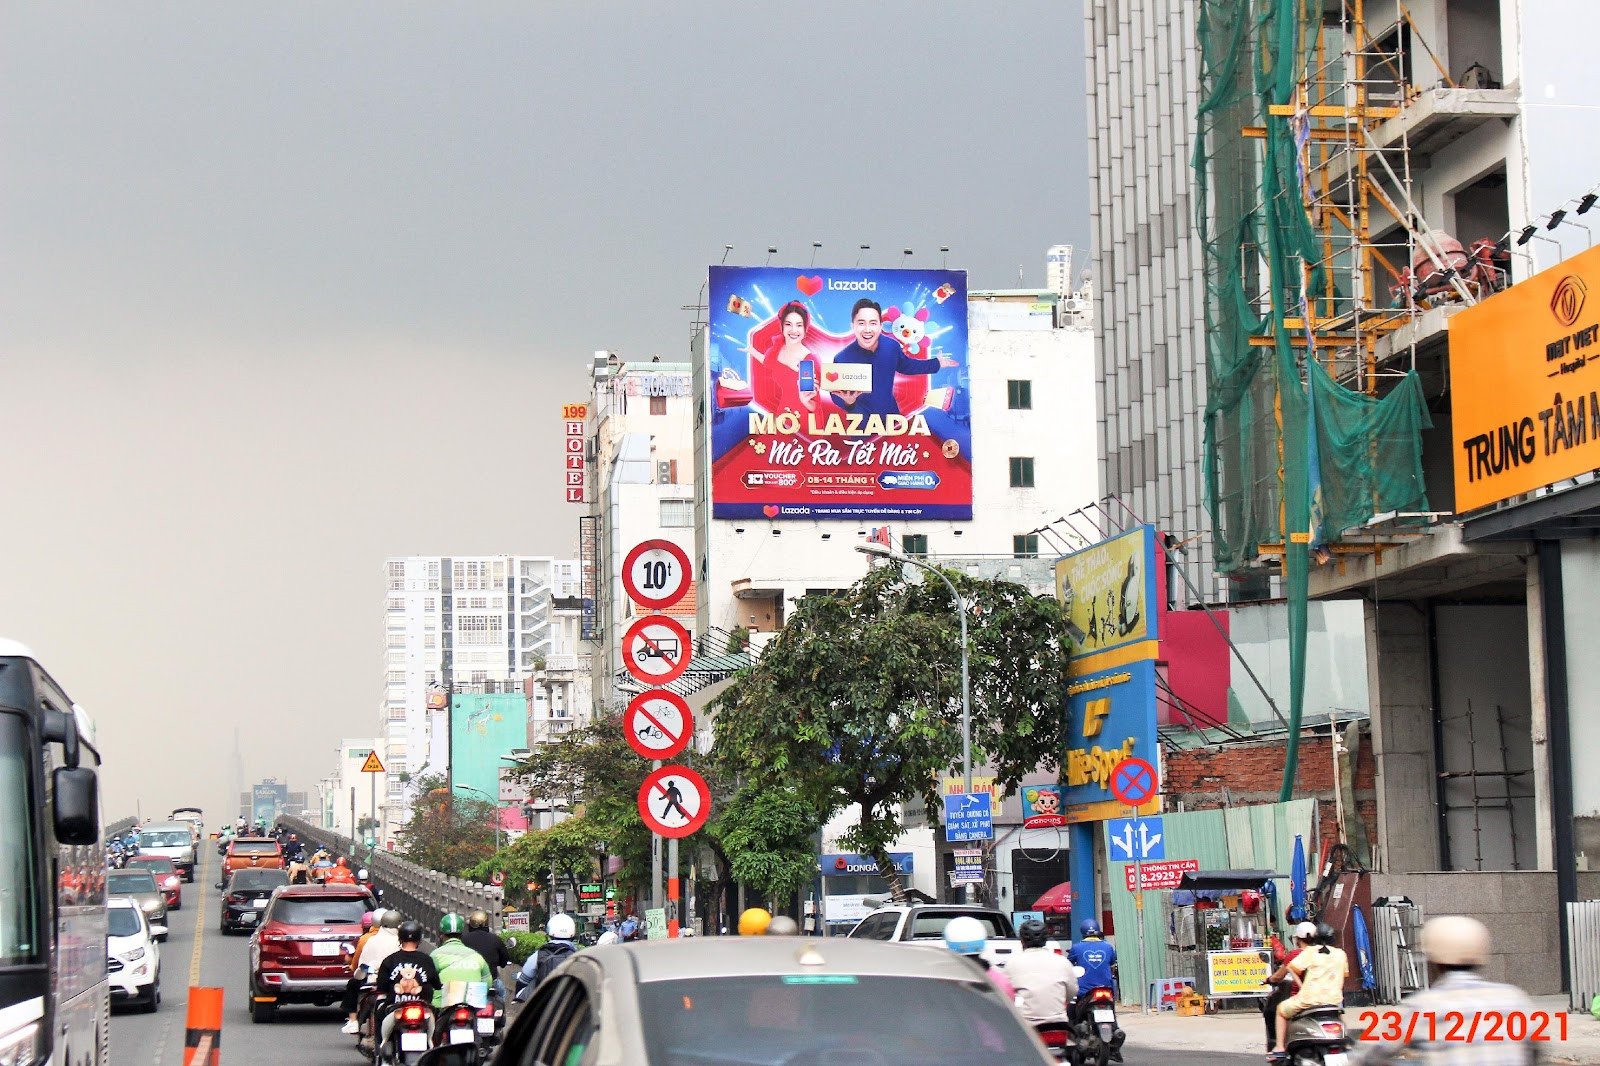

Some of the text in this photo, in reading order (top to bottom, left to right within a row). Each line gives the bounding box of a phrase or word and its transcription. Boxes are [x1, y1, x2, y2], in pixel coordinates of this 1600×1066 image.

[828, 278, 876, 291] Lazada
[563, 406, 587, 418] 199
[808, 414, 931, 436] LAZADA
[1463, 416, 1535, 482] TRUNG
[1538, 392, 1587, 456] TÂM
[768, 439, 919, 466] Mở Ra Tết Mới
[568, 422, 583, 501] HOTEL
[835, 476, 868, 484] THÁNG
[781, 506, 810, 514] Lazada
[969, 831, 987, 839] CAMERA
[1142, 864, 1168, 873] THÔNG
[1181, 861, 1196, 869] CẦN
[509, 917, 528, 925] HOTEL
